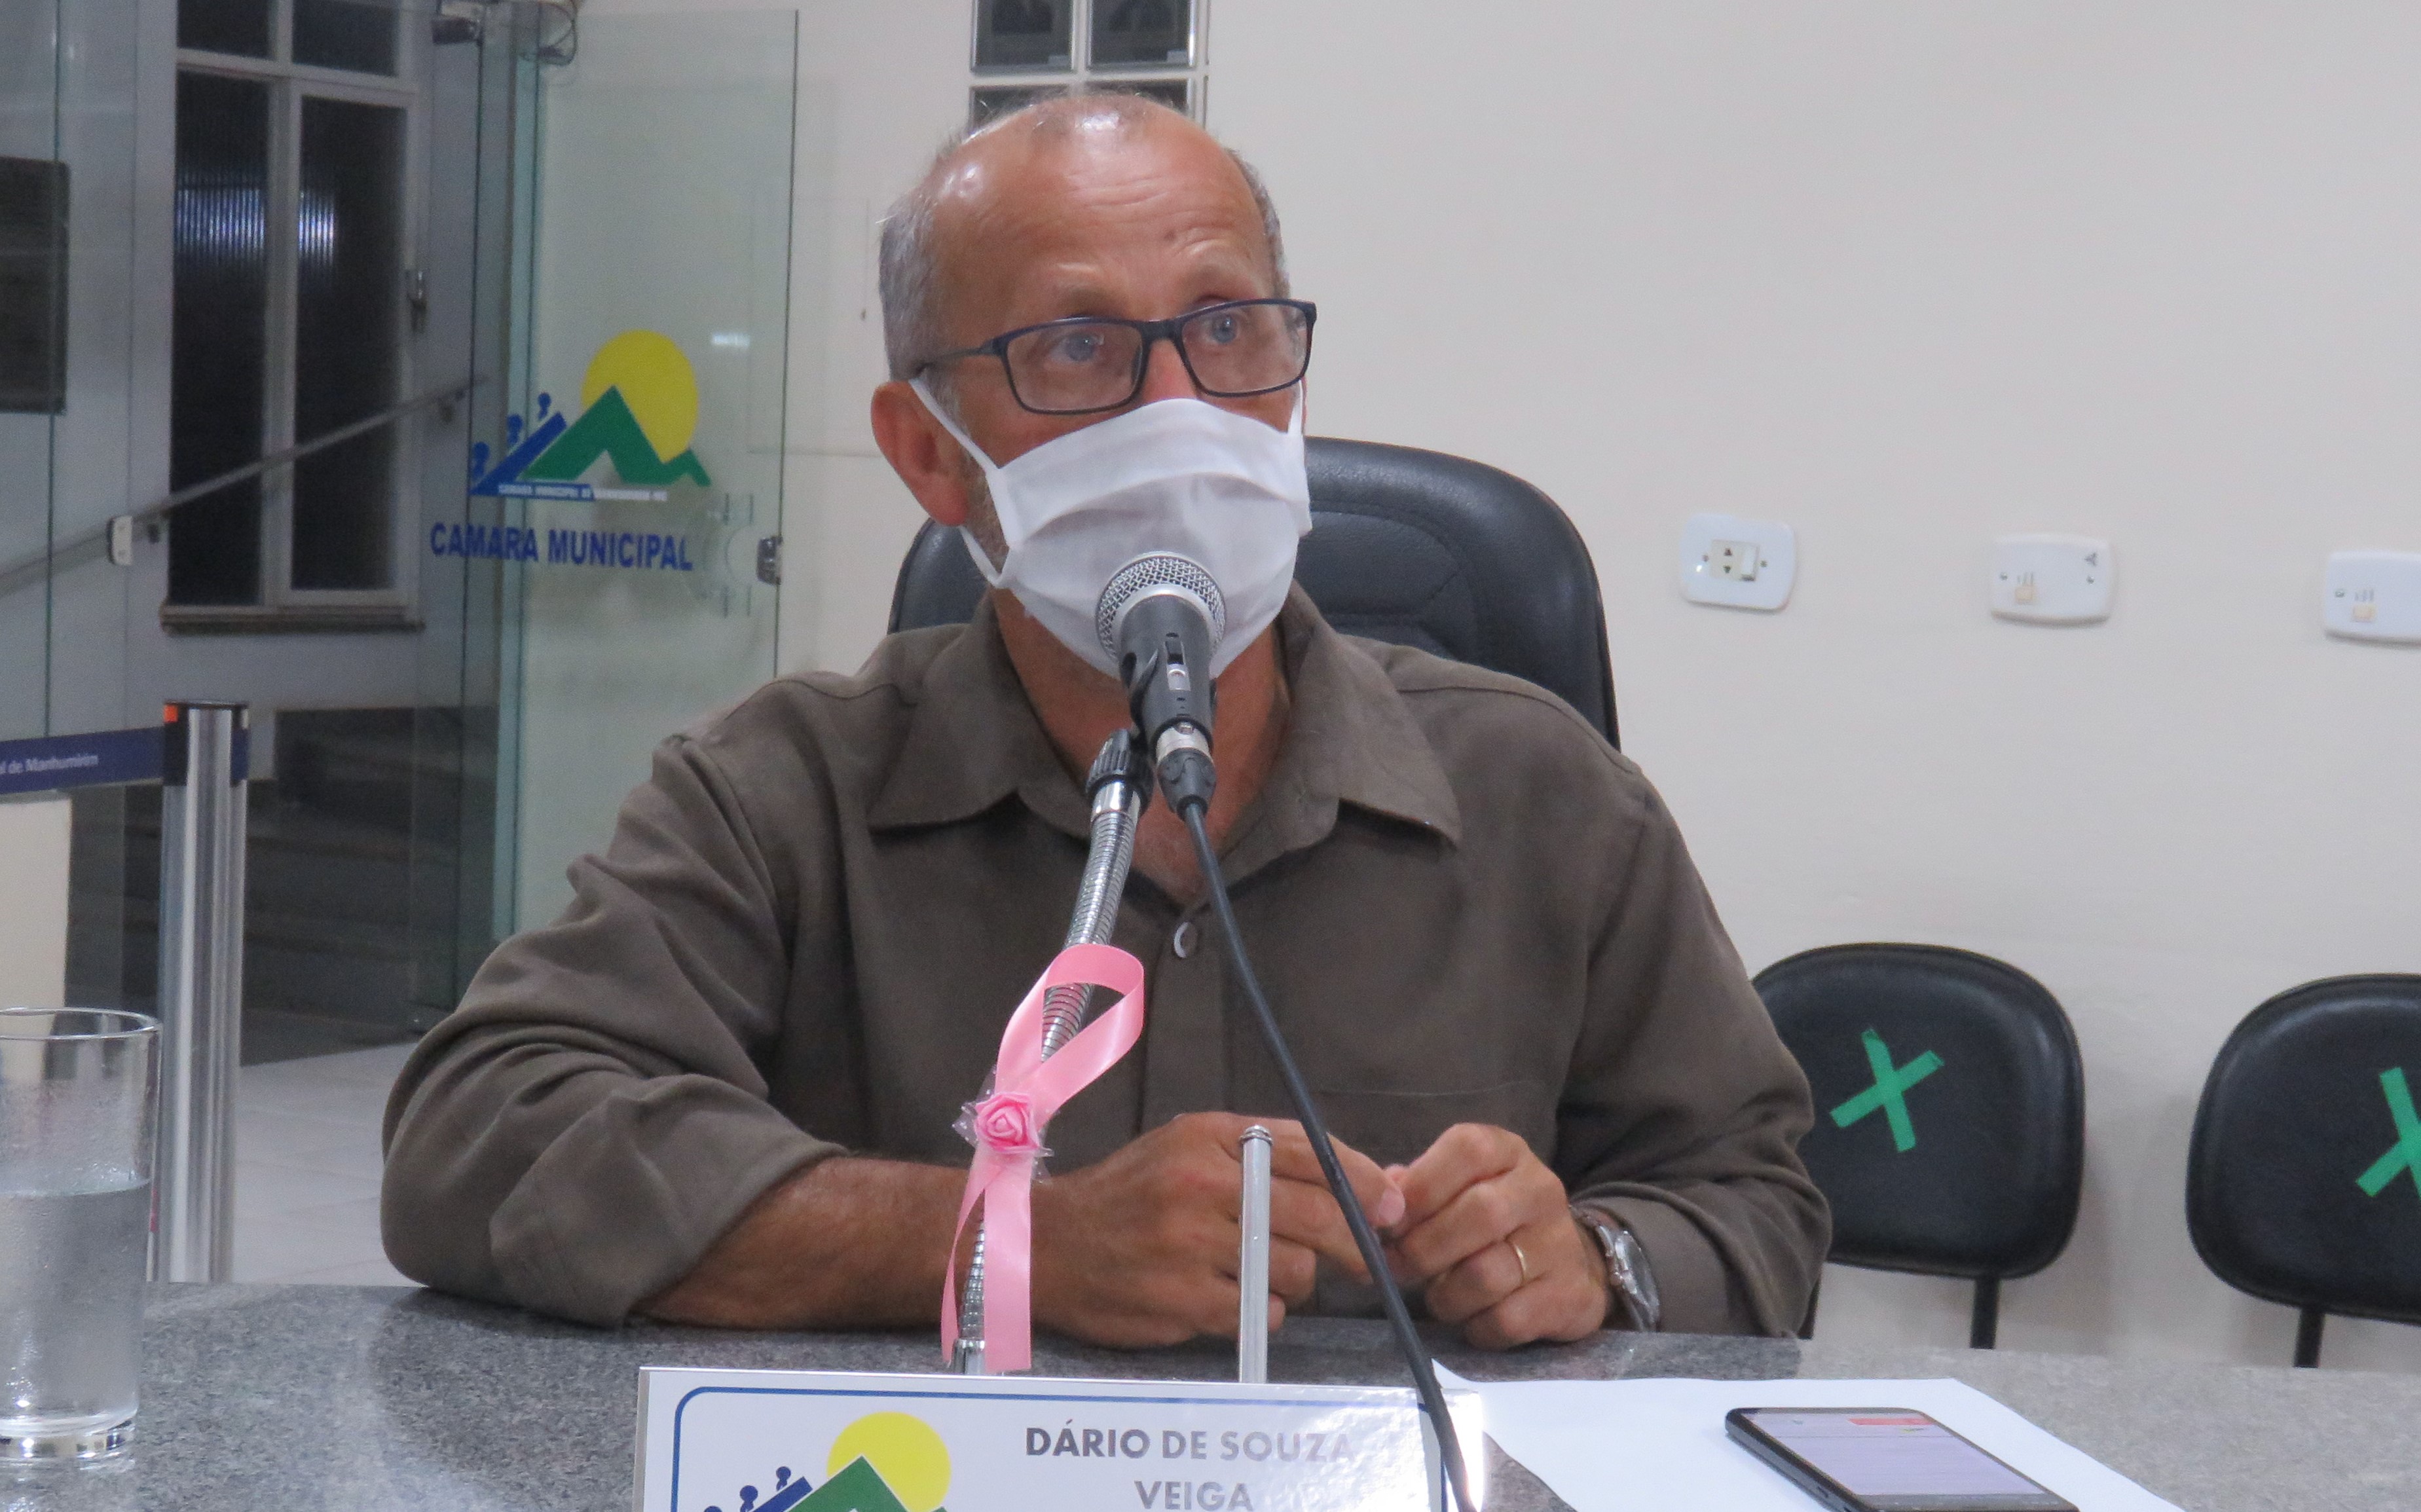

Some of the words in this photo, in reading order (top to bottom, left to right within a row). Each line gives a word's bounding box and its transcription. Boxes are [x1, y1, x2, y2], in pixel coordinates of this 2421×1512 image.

[430, 522, 539, 562] CAMARA
[548, 529, 693, 571] MUNICIPAL
[1026, 1418, 1151, 1459] DÁRIO
[1162, 1430, 1208, 1460] DE
[1220, 1431, 1354, 1463] SOUZA
[1134, 1480, 1254, 1511] VEIGA
